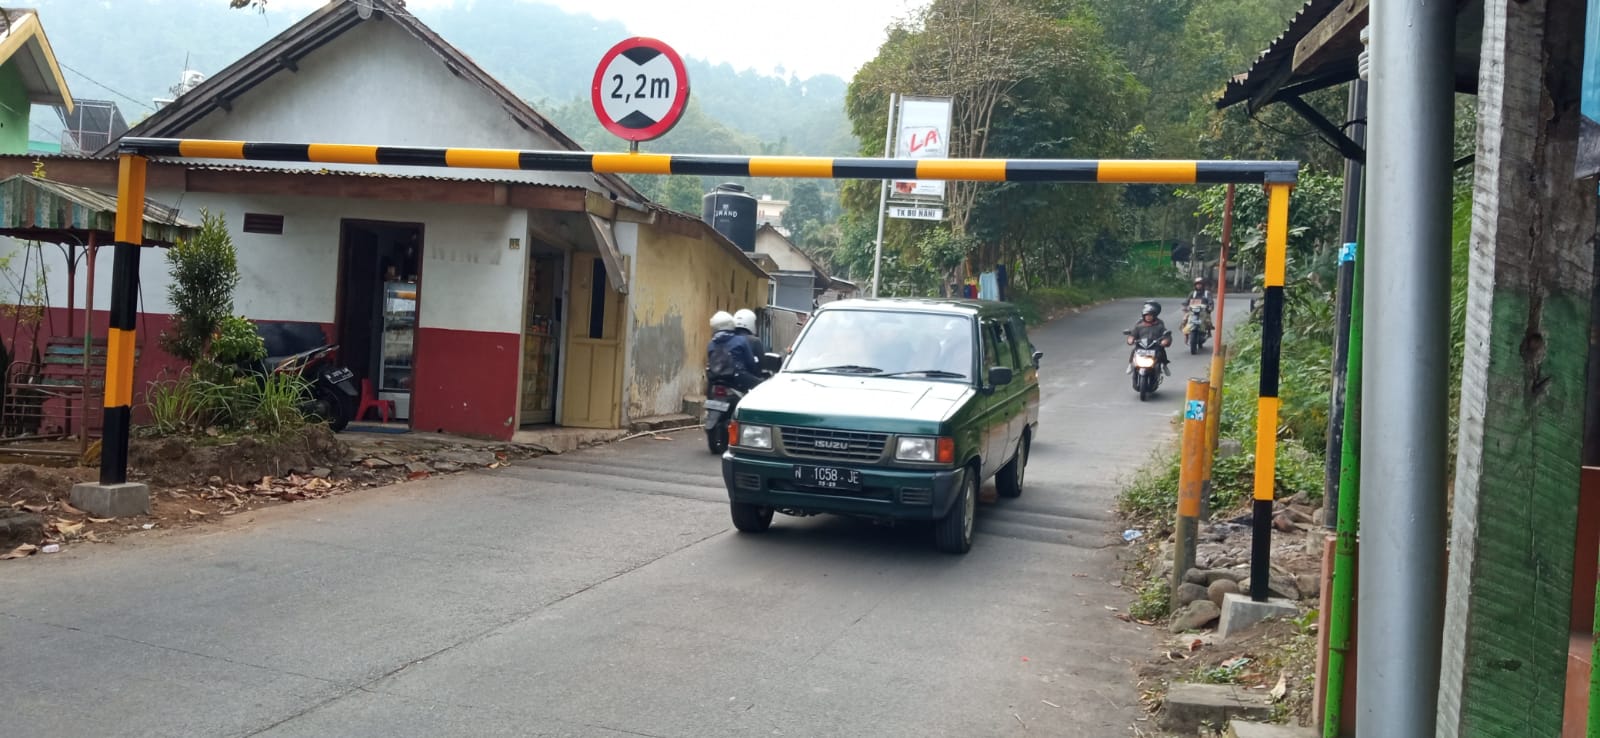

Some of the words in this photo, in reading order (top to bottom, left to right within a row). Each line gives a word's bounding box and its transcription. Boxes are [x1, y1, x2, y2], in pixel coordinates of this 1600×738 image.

[611, 74, 670, 104] 2,2m
[911, 130, 937, 152] LA
[897, 208, 905, 217] TK
[907, 209, 916, 218] BU
[815, 440, 848, 449] ISUZU
[795, 466, 802, 479] N
[848, 471, 859, 484] JE
